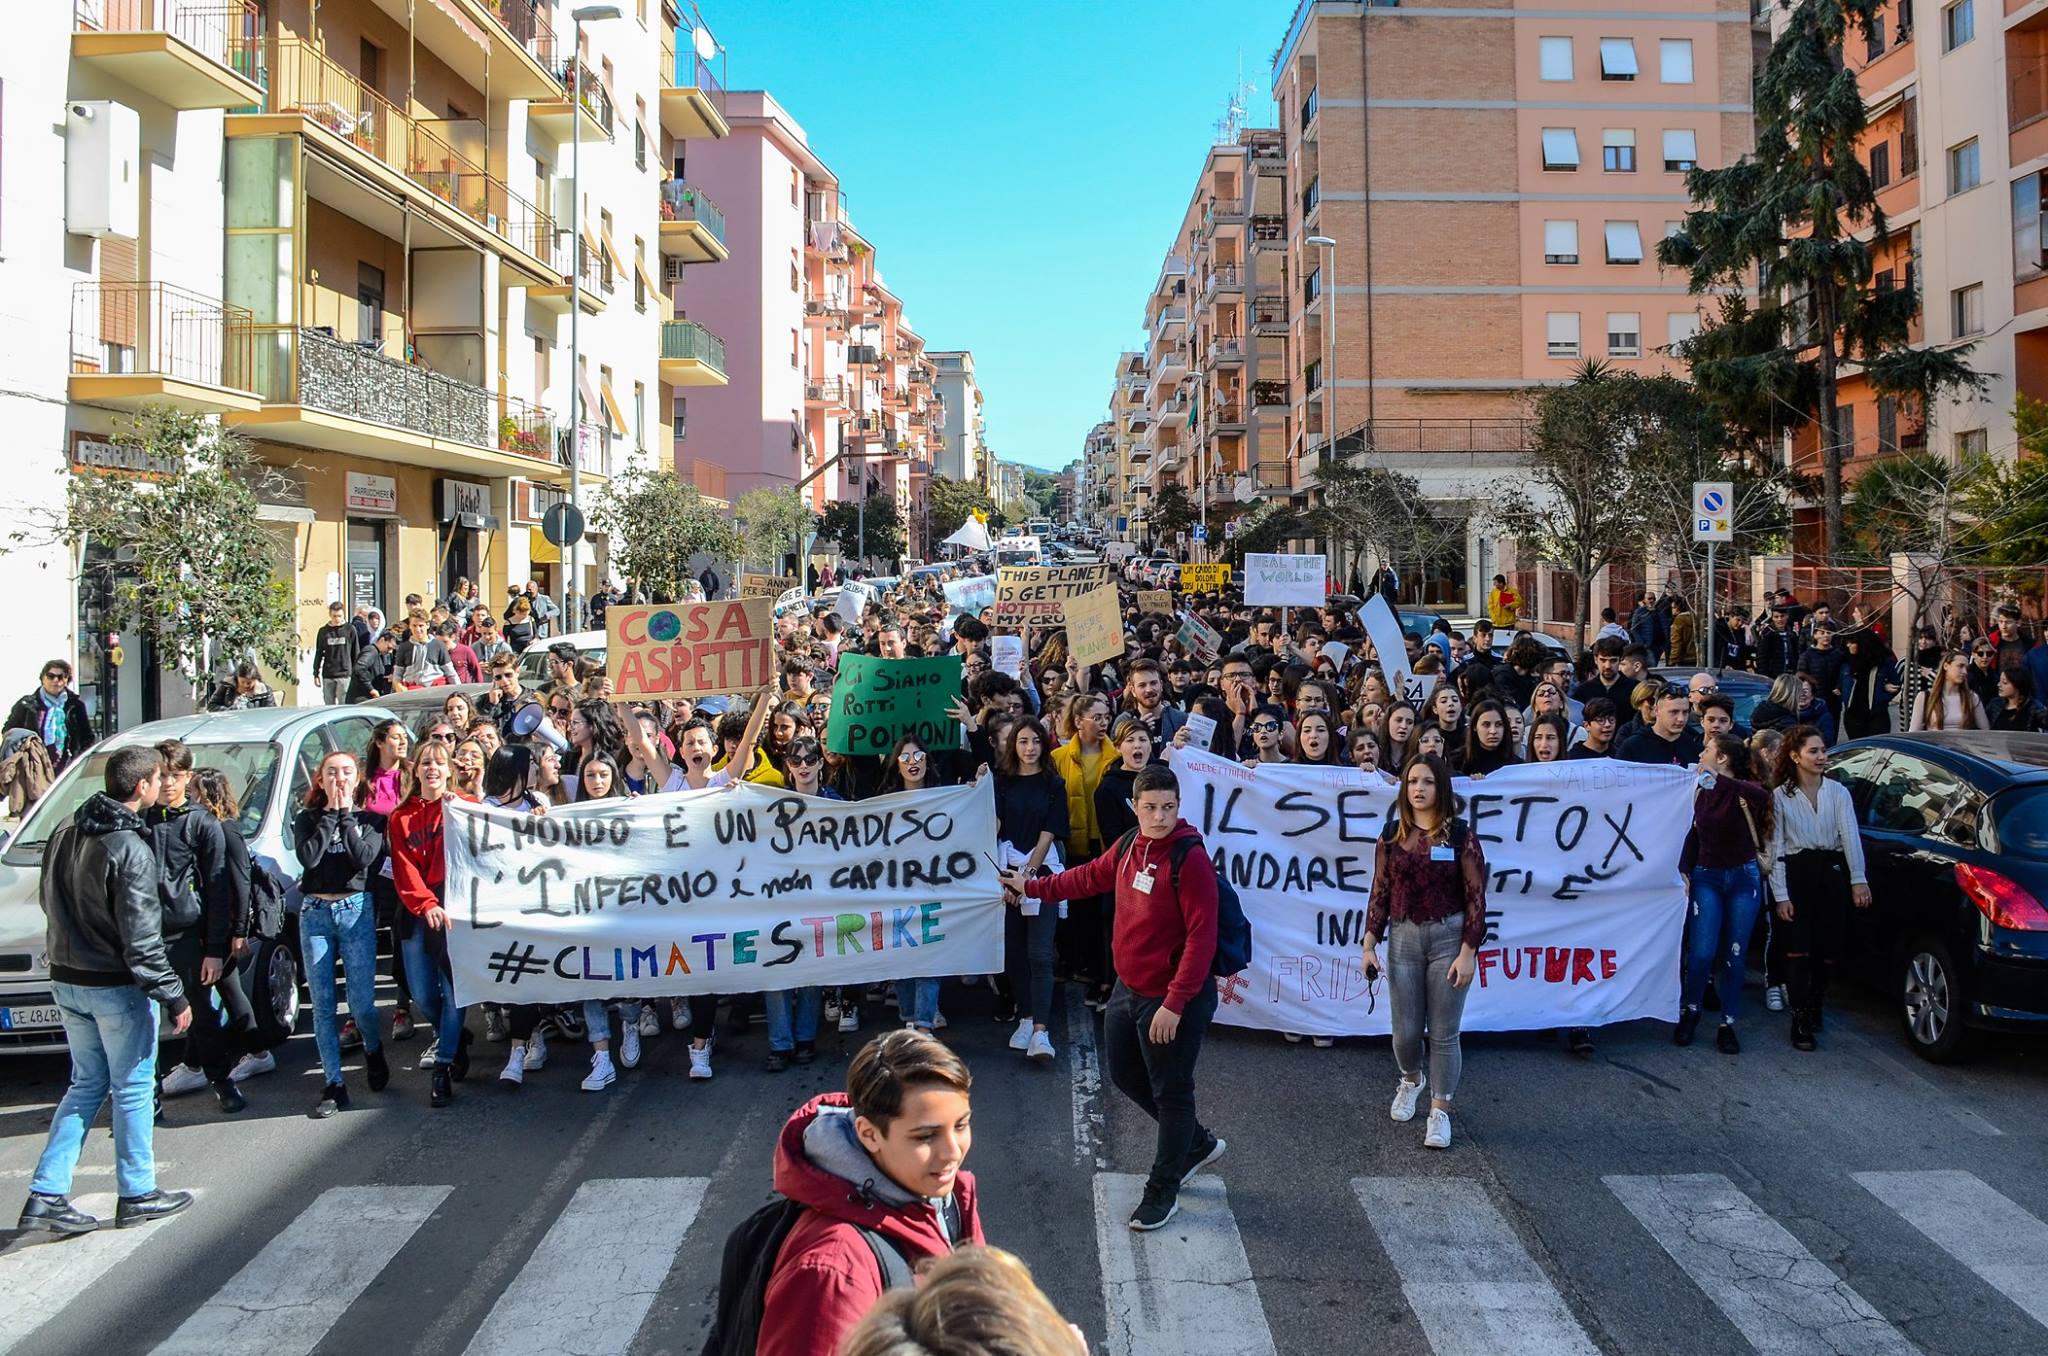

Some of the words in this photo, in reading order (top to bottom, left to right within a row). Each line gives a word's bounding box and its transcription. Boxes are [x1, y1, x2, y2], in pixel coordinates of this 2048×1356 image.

[1254, 556, 1288, 569] HEAL
[1294, 556, 1321, 570] THE
[1001, 570, 1040, 582] THIS
[1047, 565, 1109, 582] PLANET
[1260, 571, 1313, 583] WORLD
[743, 586, 758, 597] PER
[767, 579, 790, 589] ANNI
[1000, 586, 1013, 602] IS
[1019, 583, 1104, 602] GETTING
[996, 602, 1062, 615] HOTTER
[996, 615, 1026, 625] MY
[615, 638, 770, 694] ASPETTI
[467, 812, 506, 858] IL
[511, 815, 630, 851] MONDO
[713, 808, 757, 845] UN
[1203, 782, 1258, 836] IL
[1274, 785, 1589, 852] SEETO
[1602, 802, 1645, 870] X
[829, 851, 977, 890] CAPIRLO
[1211, 846, 1369, 894] ANDARE
[1477, 946, 1618, 988] FUTURE
[12, 1011, 26, 1025] CE
